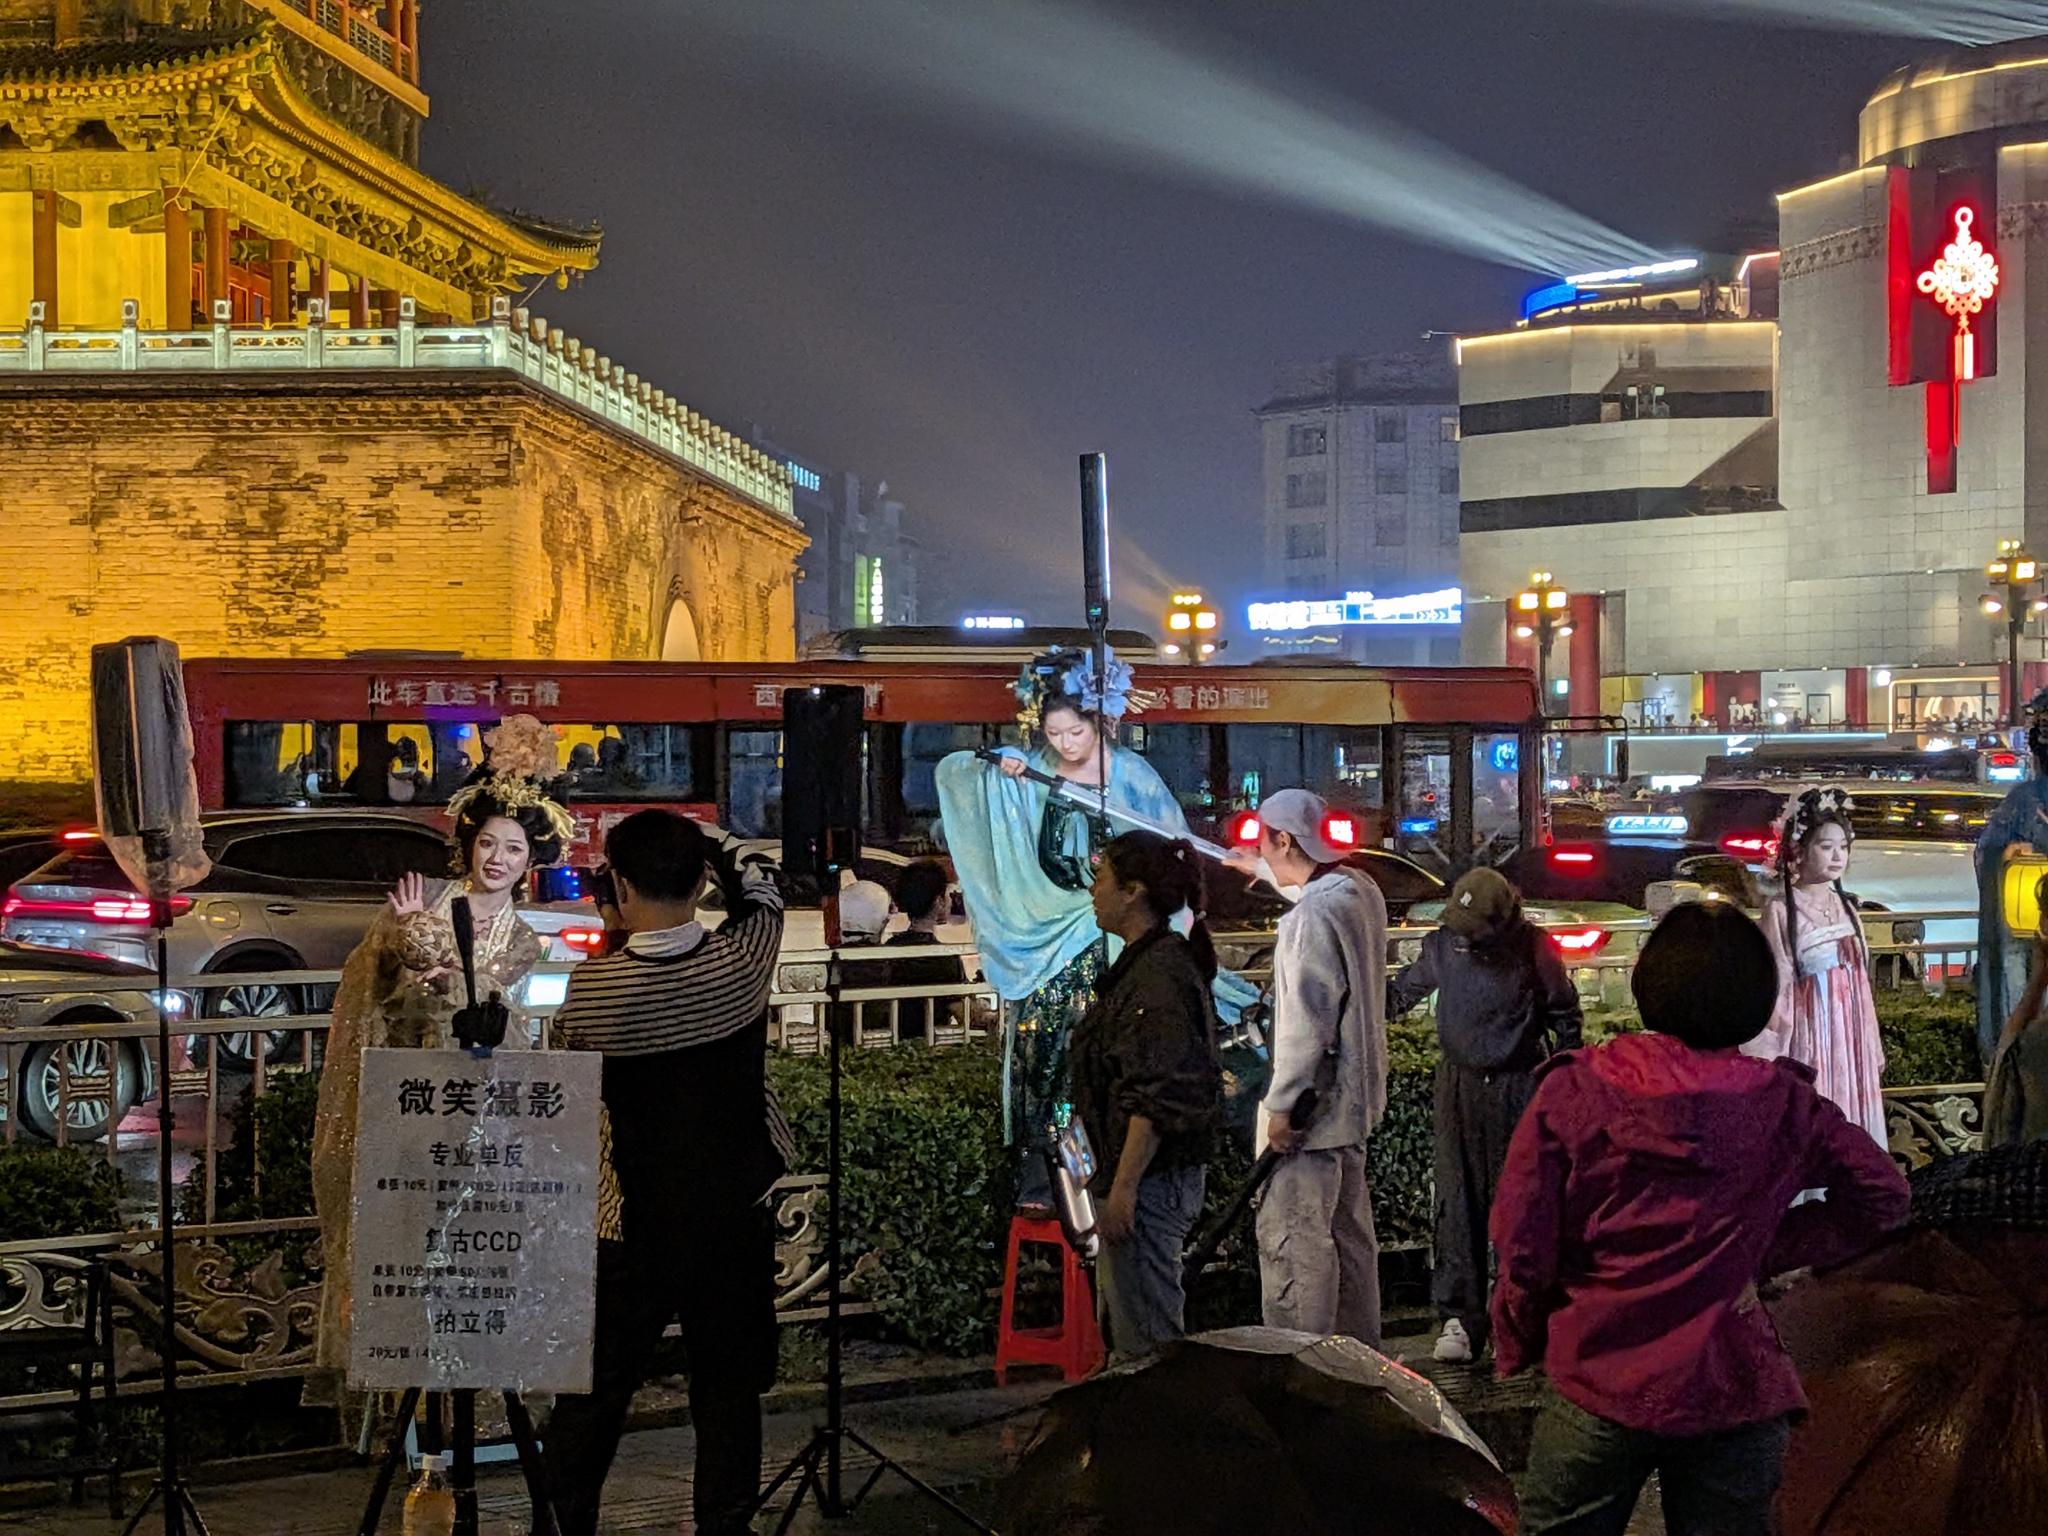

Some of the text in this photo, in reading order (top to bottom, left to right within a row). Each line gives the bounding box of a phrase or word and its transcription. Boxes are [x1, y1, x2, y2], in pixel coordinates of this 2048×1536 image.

[398, 1078, 565, 1118] 微笑摄影
[430, 1141, 524, 1168] 专业单反
[425, 1228, 522, 1253] 复古CCD
[434, 1309, 507, 1335] 拍立得
